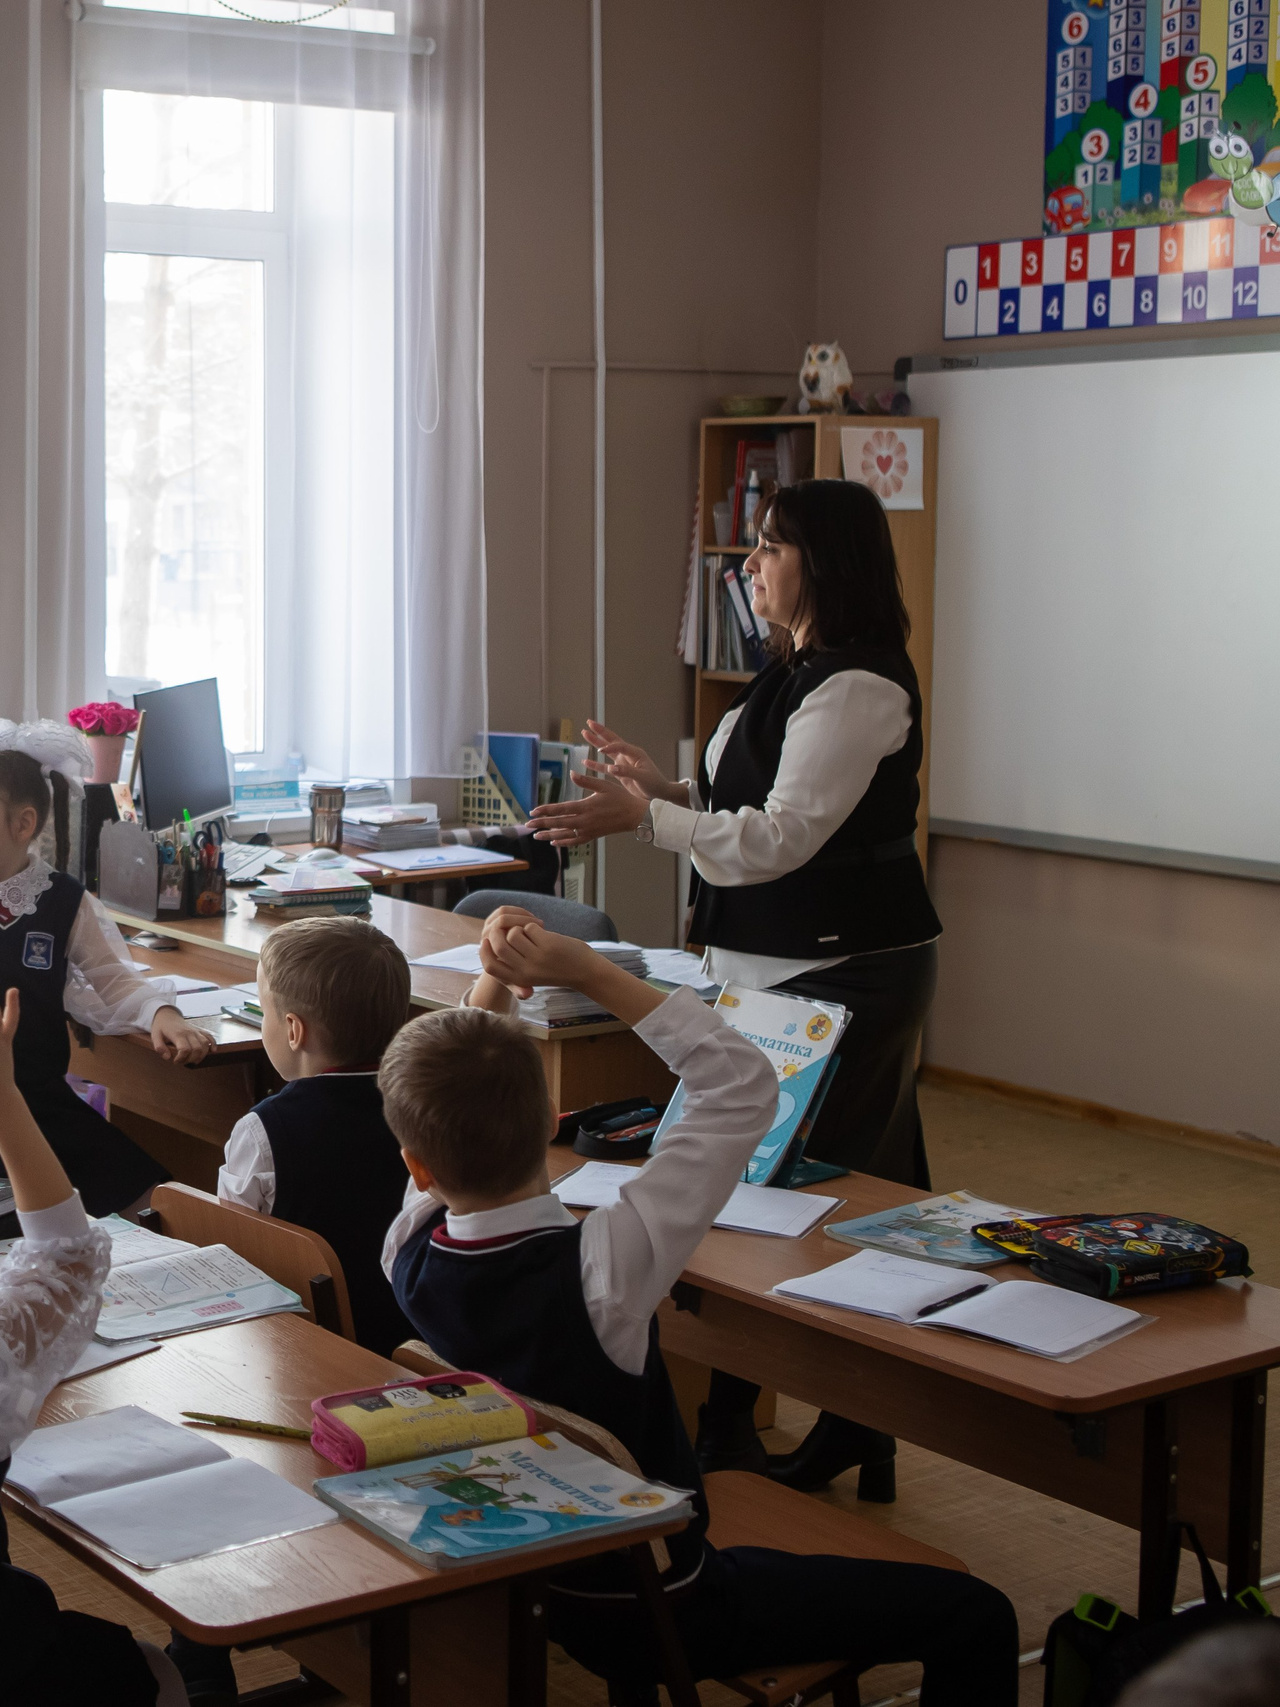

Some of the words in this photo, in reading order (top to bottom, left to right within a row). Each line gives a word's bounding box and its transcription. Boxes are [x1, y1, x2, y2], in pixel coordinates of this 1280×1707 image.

[1234, 2, 1243, 15] 6
[1068, 17, 1082, 39] 6
[1114, 15, 1122, 28] 7
[1133, 11, 1141, 25] 3
[1167, 18, 1176, 32] 6
[1186, 14, 1195, 28] 3
[1234, 24, 1243, 38] 5
[1254, 21, 1264, 35] 2
[1113, 39, 1121, 52] 6
[1132, 35, 1140, 48] 4
[1166, 43, 1175, 56] 5
[1185, 39, 1195, 52] 4
[1061, 55, 1070, 68] 5
[1081, 52, 1086, 64] 1
[1232, 48, 1242, 62] 4
[1253, 45, 1263, 59] 3
[1112, 60, 1120, 74] 5
[1131, 58, 1140, 71] 5
[1193, 61, 1208, 85] 5
[1061, 76, 1069, 89] 4
[1079, 74, 1087, 87] 2
[1060, 98, 1068, 112] 3
[1078, 96, 1086, 109] 3
[1135, 88, 1150, 111] 4
[1185, 100, 1195, 113] 4
[1206, 97, 1213, 111] 1
[1129, 127, 1137, 141] 3
[1149, 124, 1155, 138] 1
[1185, 123, 1193, 138] 3
[1089, 135, 1102, 157] 3
[1129, 149, 1137, 163] 2
[1147, 146, 1156, 160] 2
[1083, 170, 1088, 184] 1
[1099, 168, 1108, 182] 2
[982, 257, 991, 280] 1
[1025, 253, 1038, 276] 3
[1070, 248, 1083, 271] 5
[1118, 243, 1131, 267] 7
[1163, 238, 1177, 263] 9
[1212, 234, 1231, 257] 11
[954, 279, 967, 305] 0
[1003, 301, 1015, 324] 2
[1046, 297, 1060, 320] 4
[1093, 293, 1106, 317] 6
[1140, 288, 1153, 313] 8
[1184, 285, 1206, 310] 10
[1233, 281, 1257, 306] 12
[501, 1450, 615, 1513] Математика
